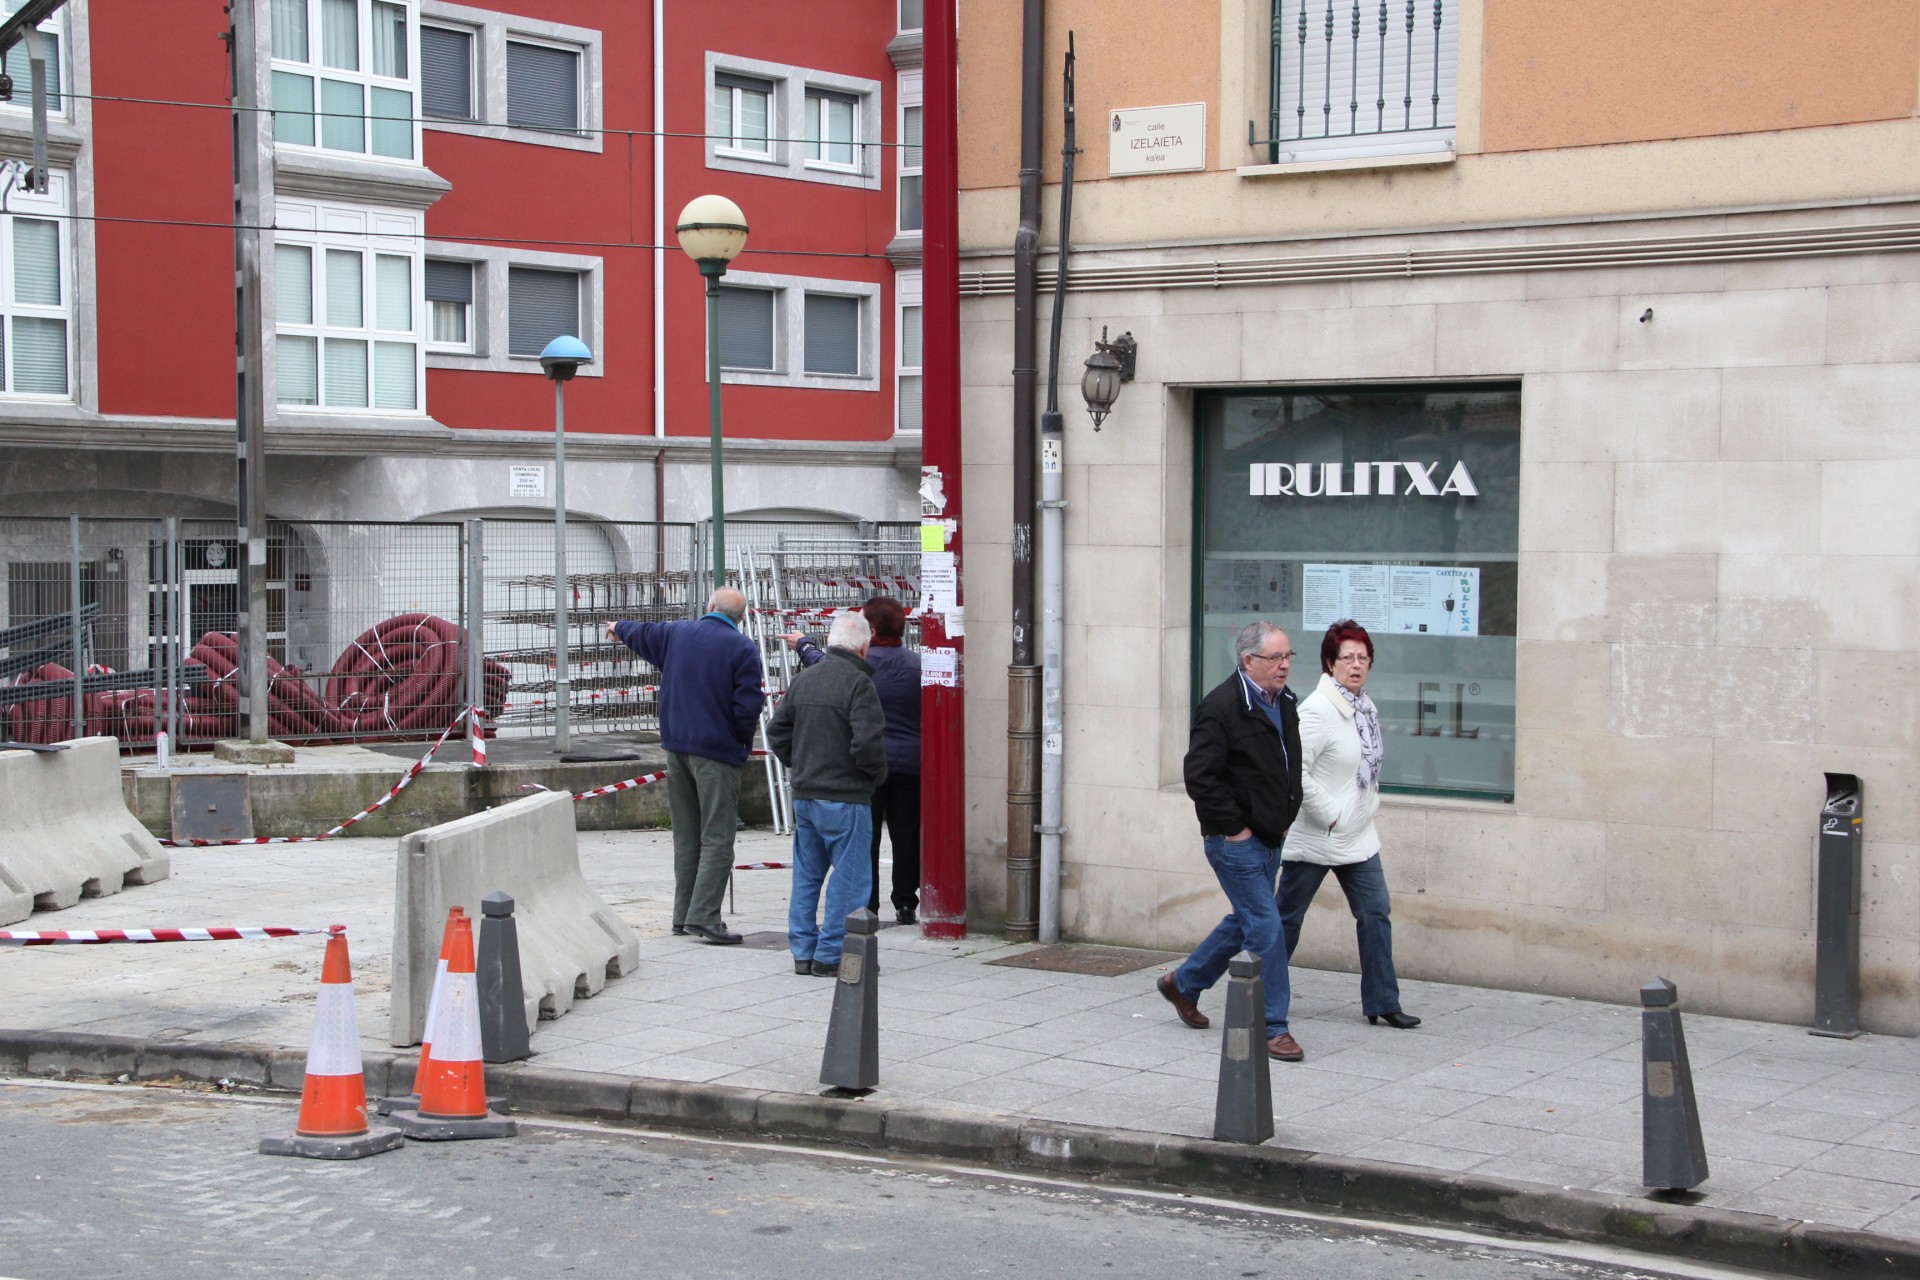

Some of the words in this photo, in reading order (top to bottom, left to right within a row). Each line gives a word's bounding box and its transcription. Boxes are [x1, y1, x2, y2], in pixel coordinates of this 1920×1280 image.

[1147, 122, 1165, 132] calle
[1130, 135, 1183, 150] IZELAIETA
[1146, 153, 1165, 162] kalea
[1250, 459, 1480, 497] IRULITXA
[208, 548, 225, 562] 22
